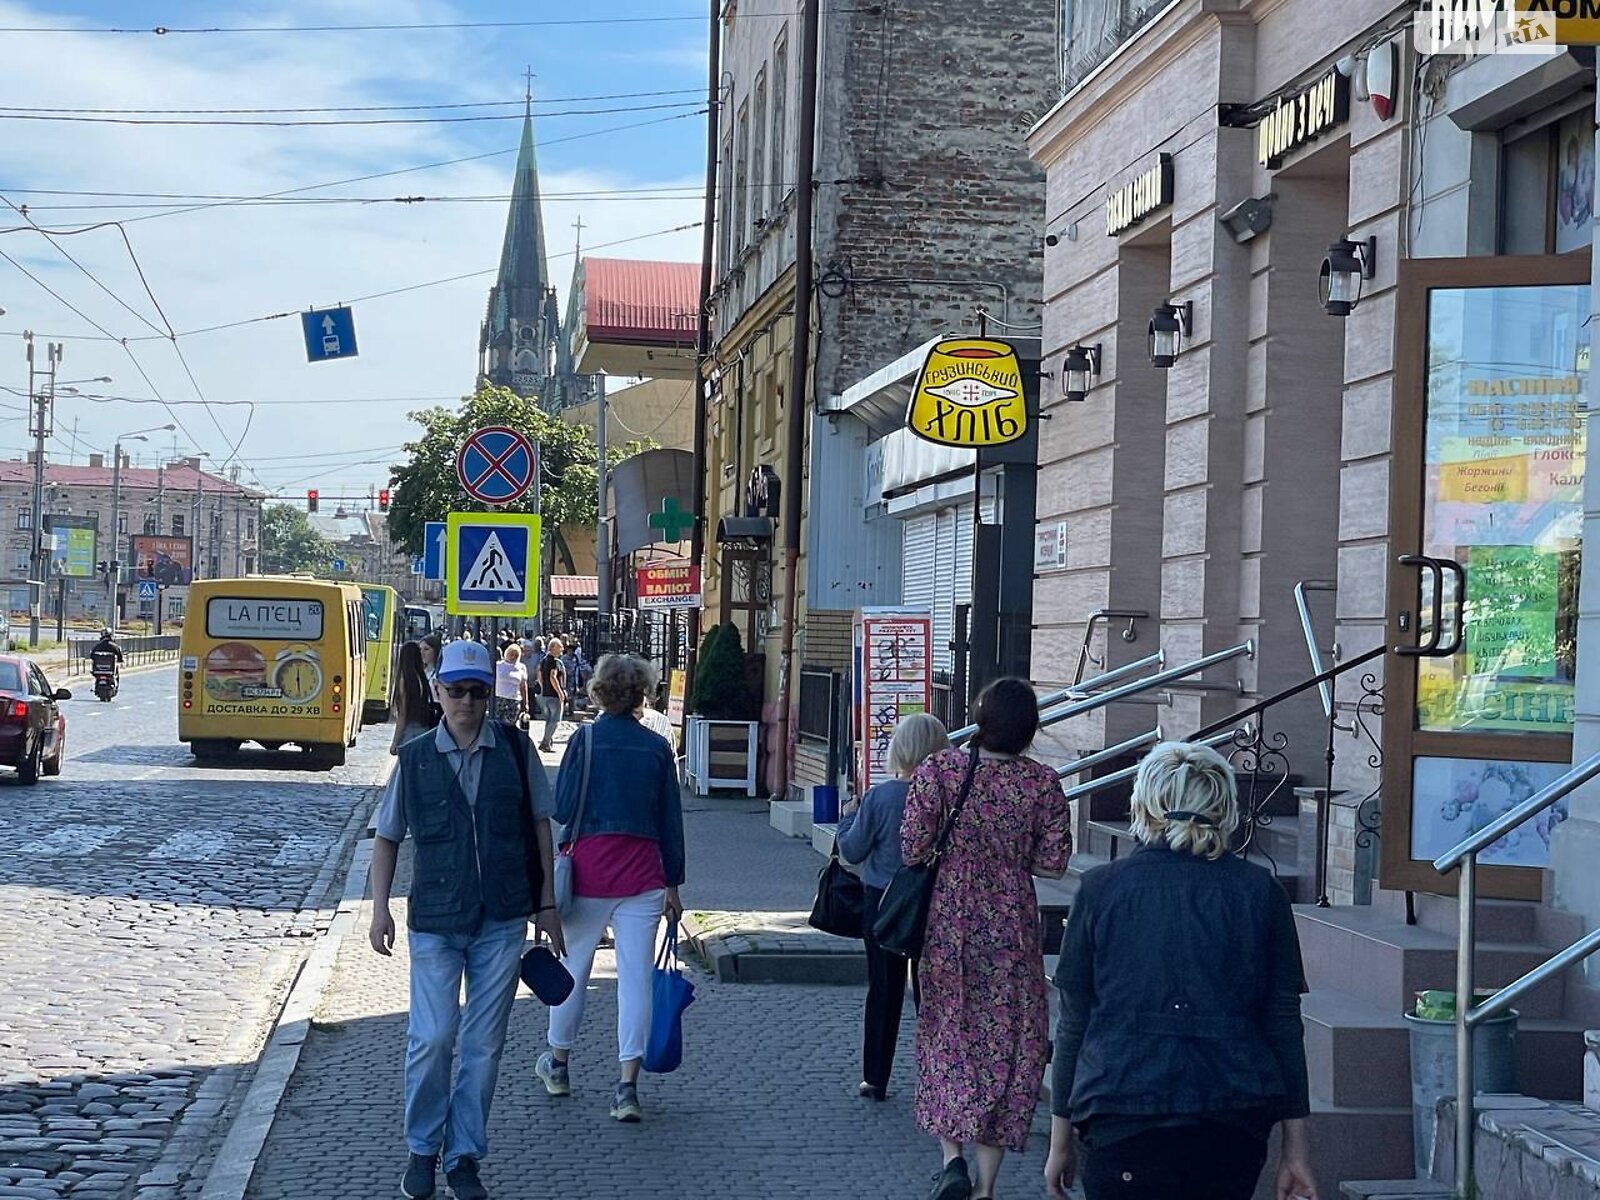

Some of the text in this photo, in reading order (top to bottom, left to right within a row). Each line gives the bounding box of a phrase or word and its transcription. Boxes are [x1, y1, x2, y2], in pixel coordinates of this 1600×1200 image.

[925, 362, 1018, 387] ГРУЗИНСЬКИЙ
[925, 401, 1019, 441] ХЛІБ
[647, 568, 689, 580] ОБМІН
[645, 583, 692, 595] ВАЛЮТ
[644, 595, 695, 605] EXCHANGE
[228, 604, 251, 621] LA
[207, 704, 320, 715] ДОСТАВКА ДО 29 ХВ
